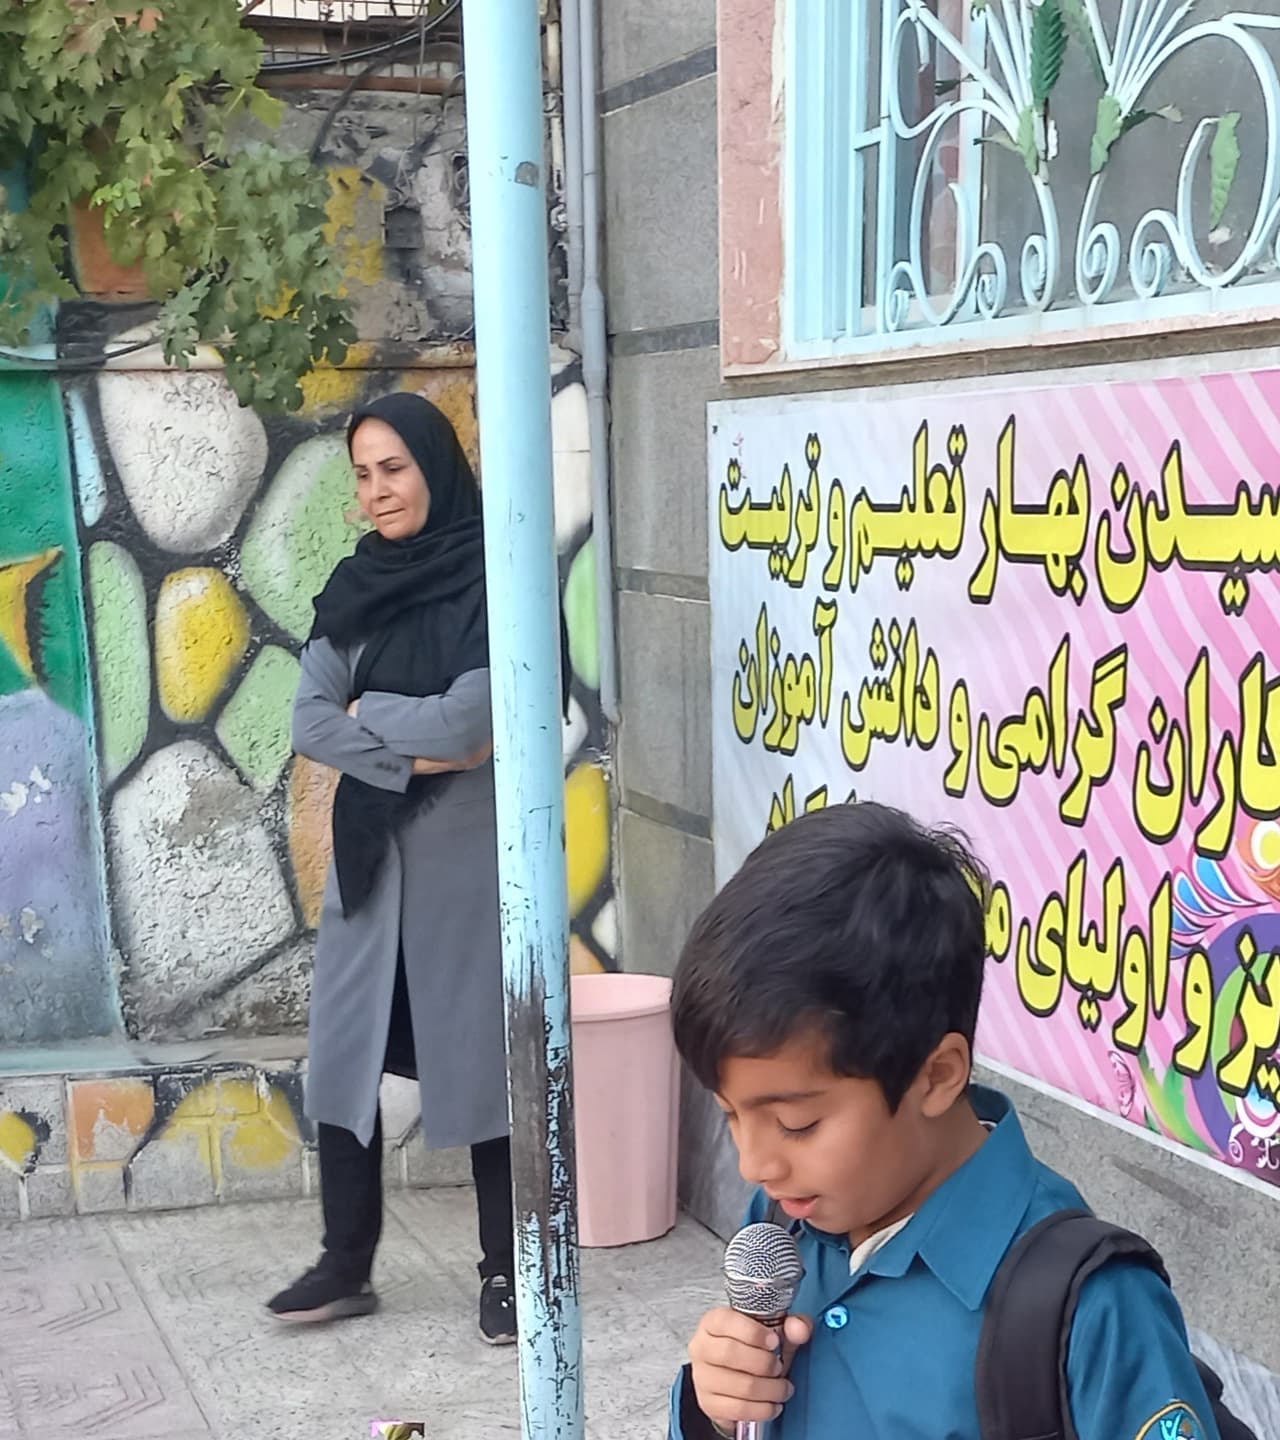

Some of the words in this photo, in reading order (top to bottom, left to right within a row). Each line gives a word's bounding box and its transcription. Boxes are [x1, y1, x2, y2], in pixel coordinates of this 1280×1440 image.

[718, 432, 822, 589] تربیت
[822, 478, 847, 592] و
[848, 418, 970, 594] تعلیم
[966, 415, 1091, 602] بهار
[729, 596, 839, 758] آموزان
[839, 617, 941, 771] دانش
[943, 677, 972, 799] و
[974, 633, 1129, 826] گرامی
[1013, 850, 1174, 1053] اولیای
[1172, 940, 1216, 1078] و
